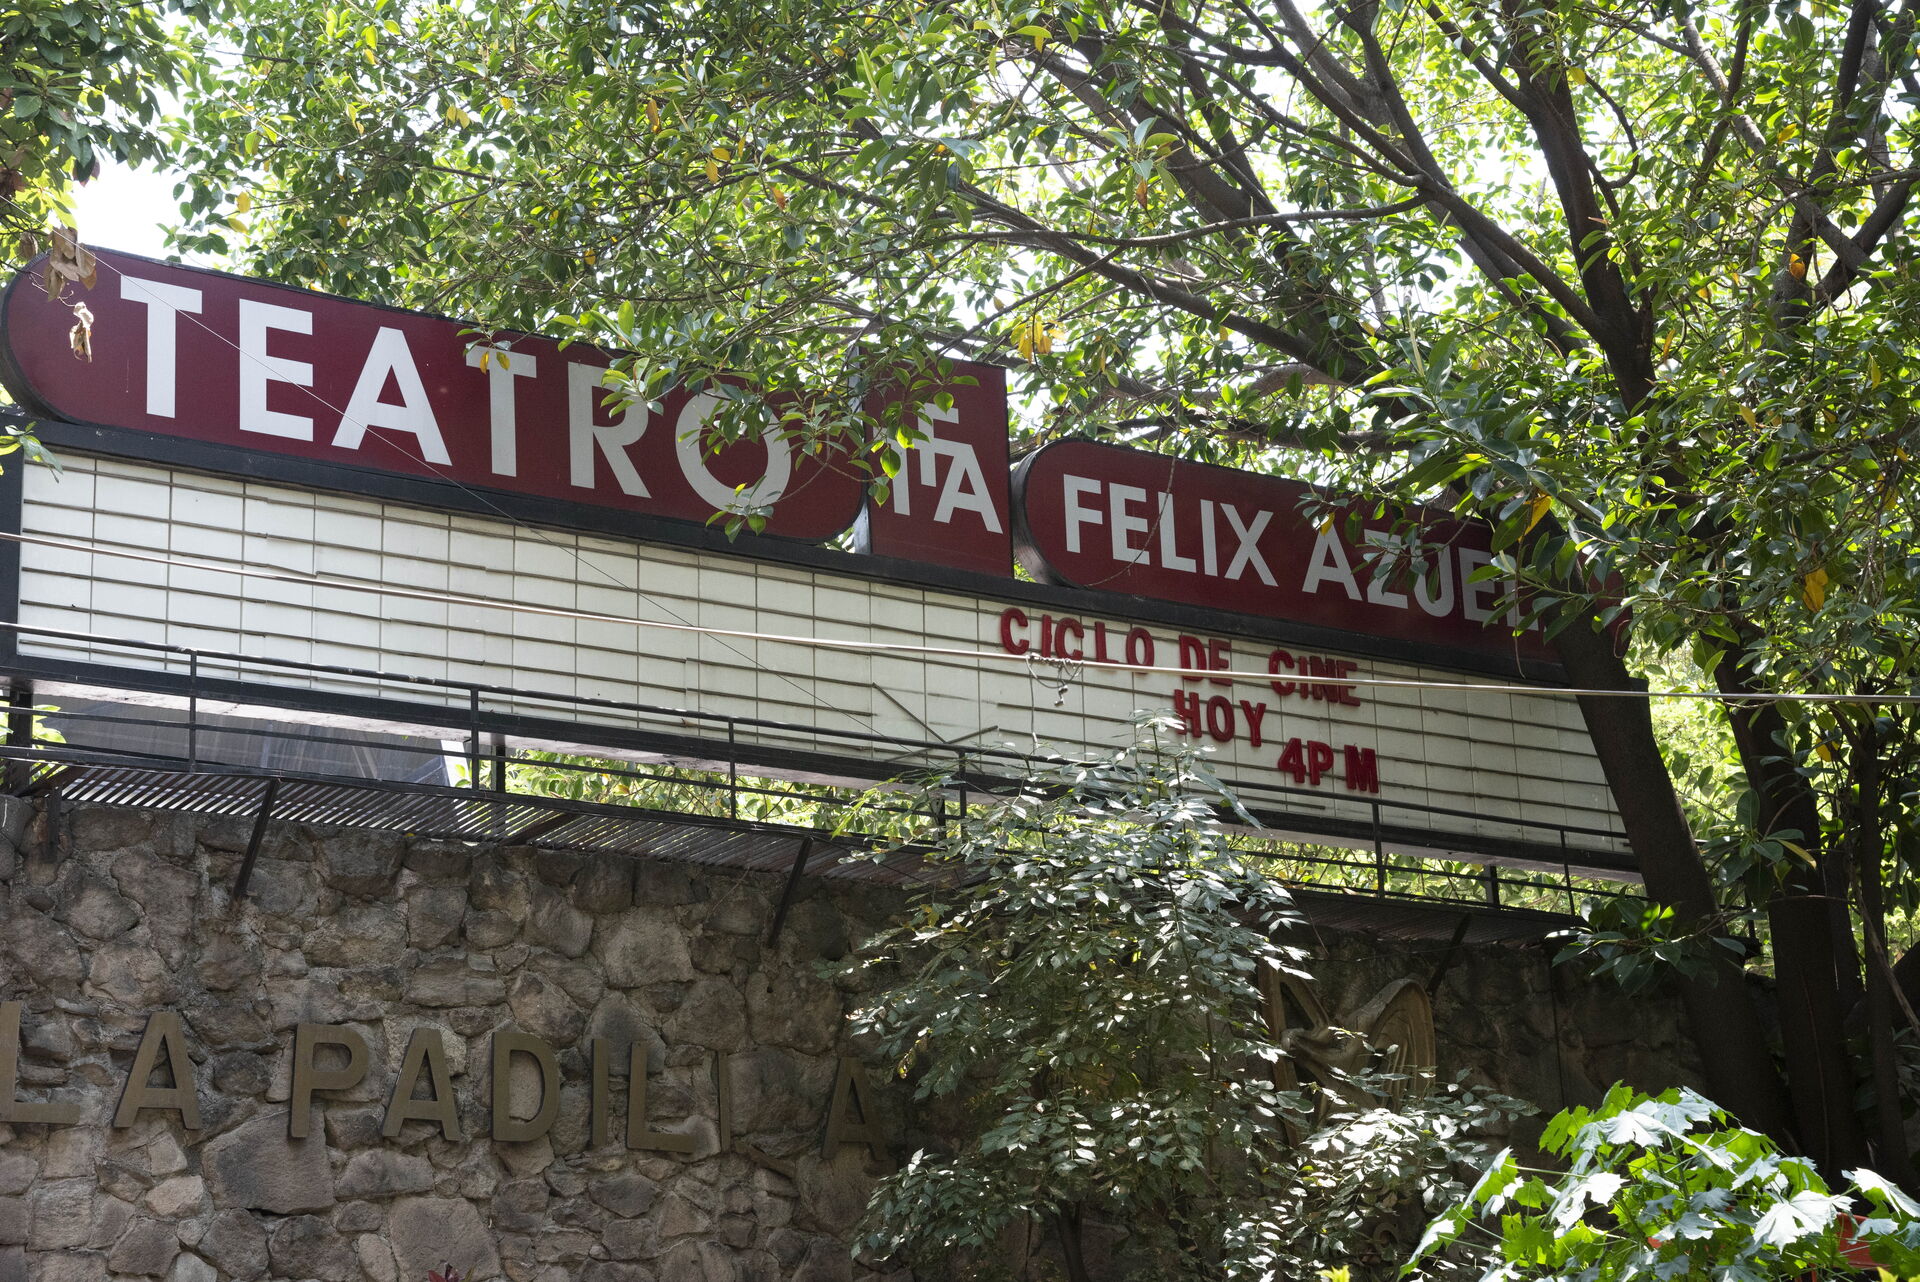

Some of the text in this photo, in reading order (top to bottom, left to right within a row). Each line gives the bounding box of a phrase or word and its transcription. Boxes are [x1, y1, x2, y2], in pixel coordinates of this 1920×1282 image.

[120, 275, 792, 517] TEATRO
[1063, 474, 1547, 631] FELIX AZUEL
[1000, 608, 1361, 707] CICLO DE CINE
[1174, 689, 1267, 747] HOY
[0, 1000, 202, 1130] LA
